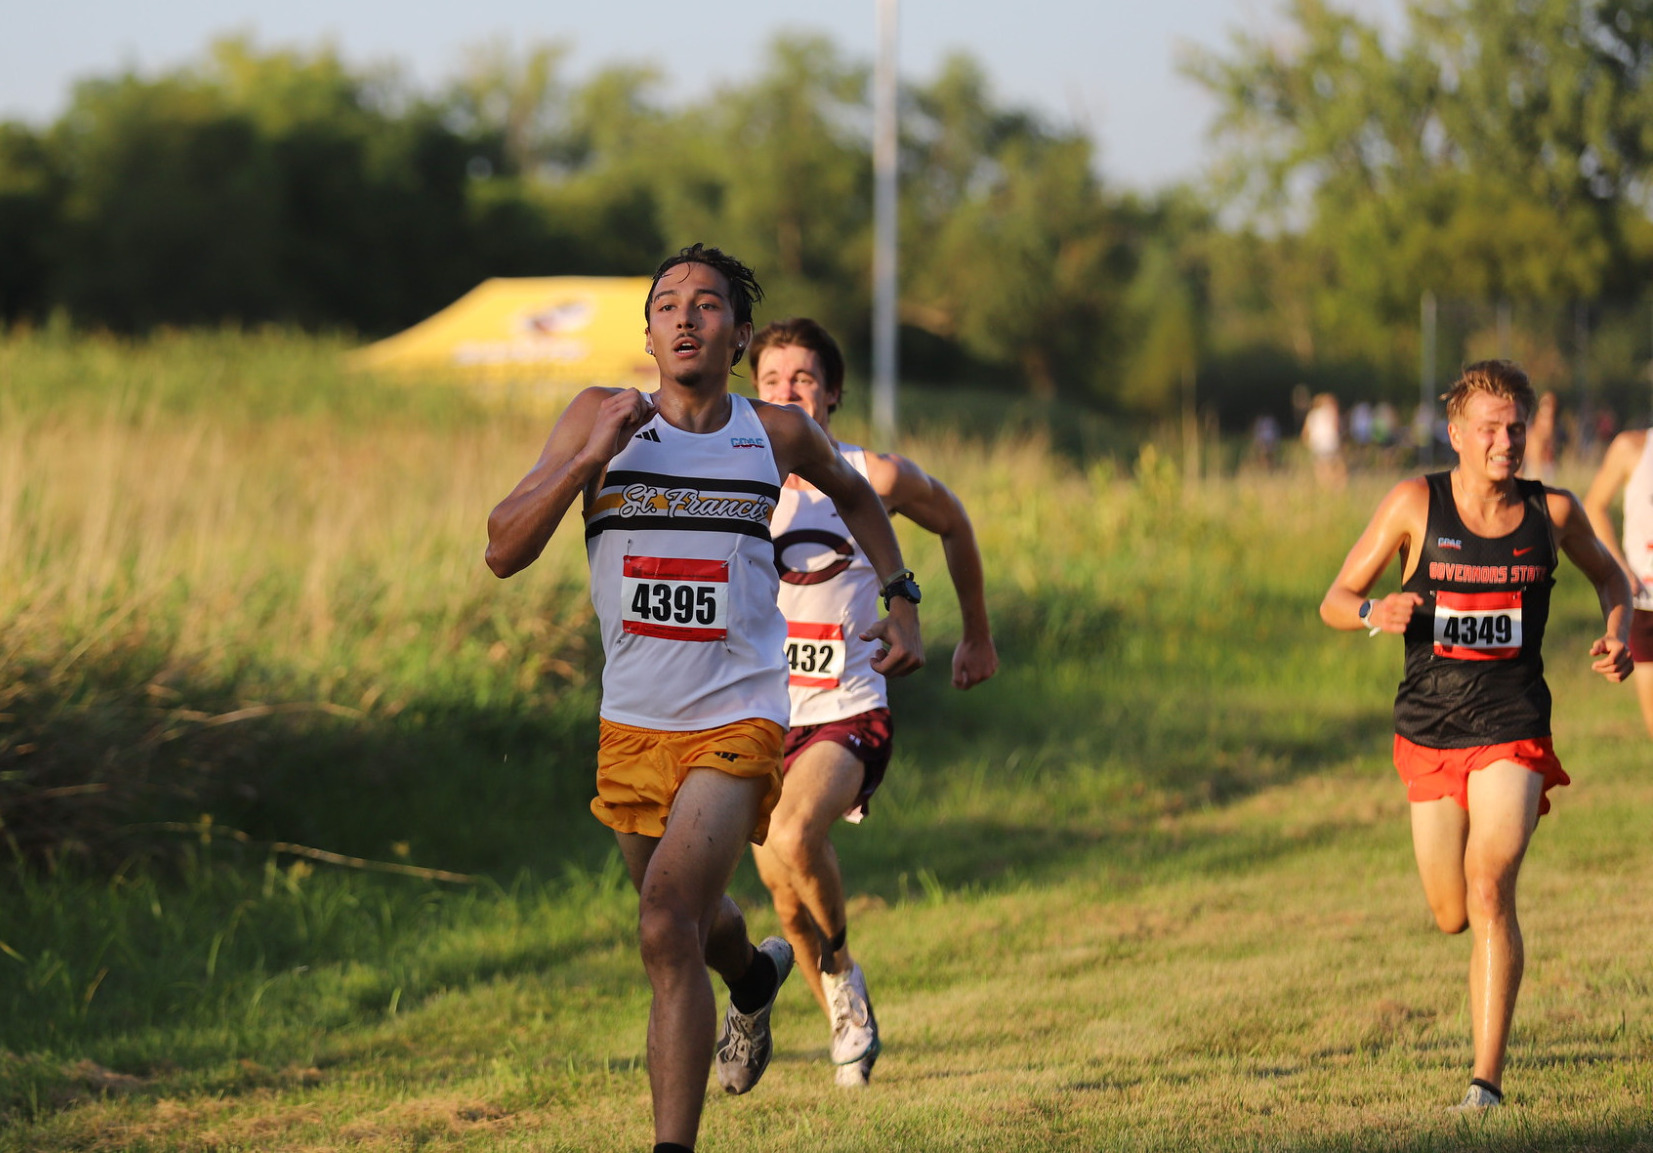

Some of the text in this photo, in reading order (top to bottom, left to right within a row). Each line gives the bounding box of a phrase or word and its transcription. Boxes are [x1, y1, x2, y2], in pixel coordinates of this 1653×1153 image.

[619, 483, 769, 521] St. Francis
[1429, 561, 1508, 584] GOVERNORS
[632, 583, 716, 625] 4395
[1443, 614, 1512, 645] 4349
